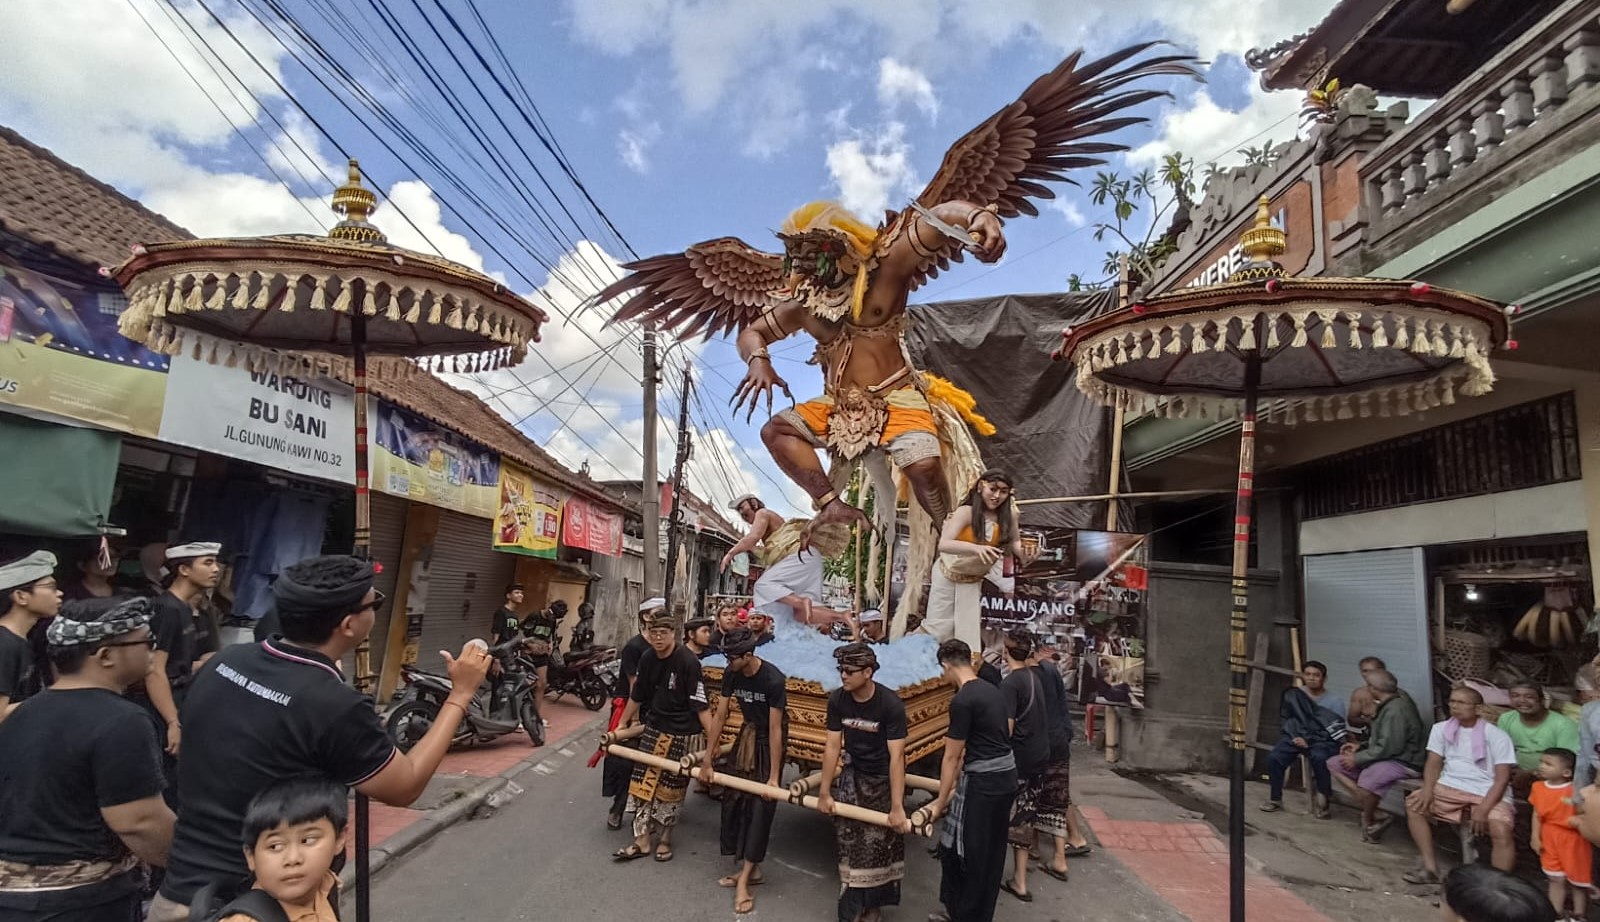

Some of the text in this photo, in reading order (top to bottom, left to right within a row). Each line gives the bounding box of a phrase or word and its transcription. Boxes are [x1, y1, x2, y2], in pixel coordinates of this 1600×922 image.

[250, 369, 332, 410] WARUNG
[249, 397, 327, 439] BU SANI
[287, 443, 312, 460] KAWI
[313, 449, 342, 467] NO.32
